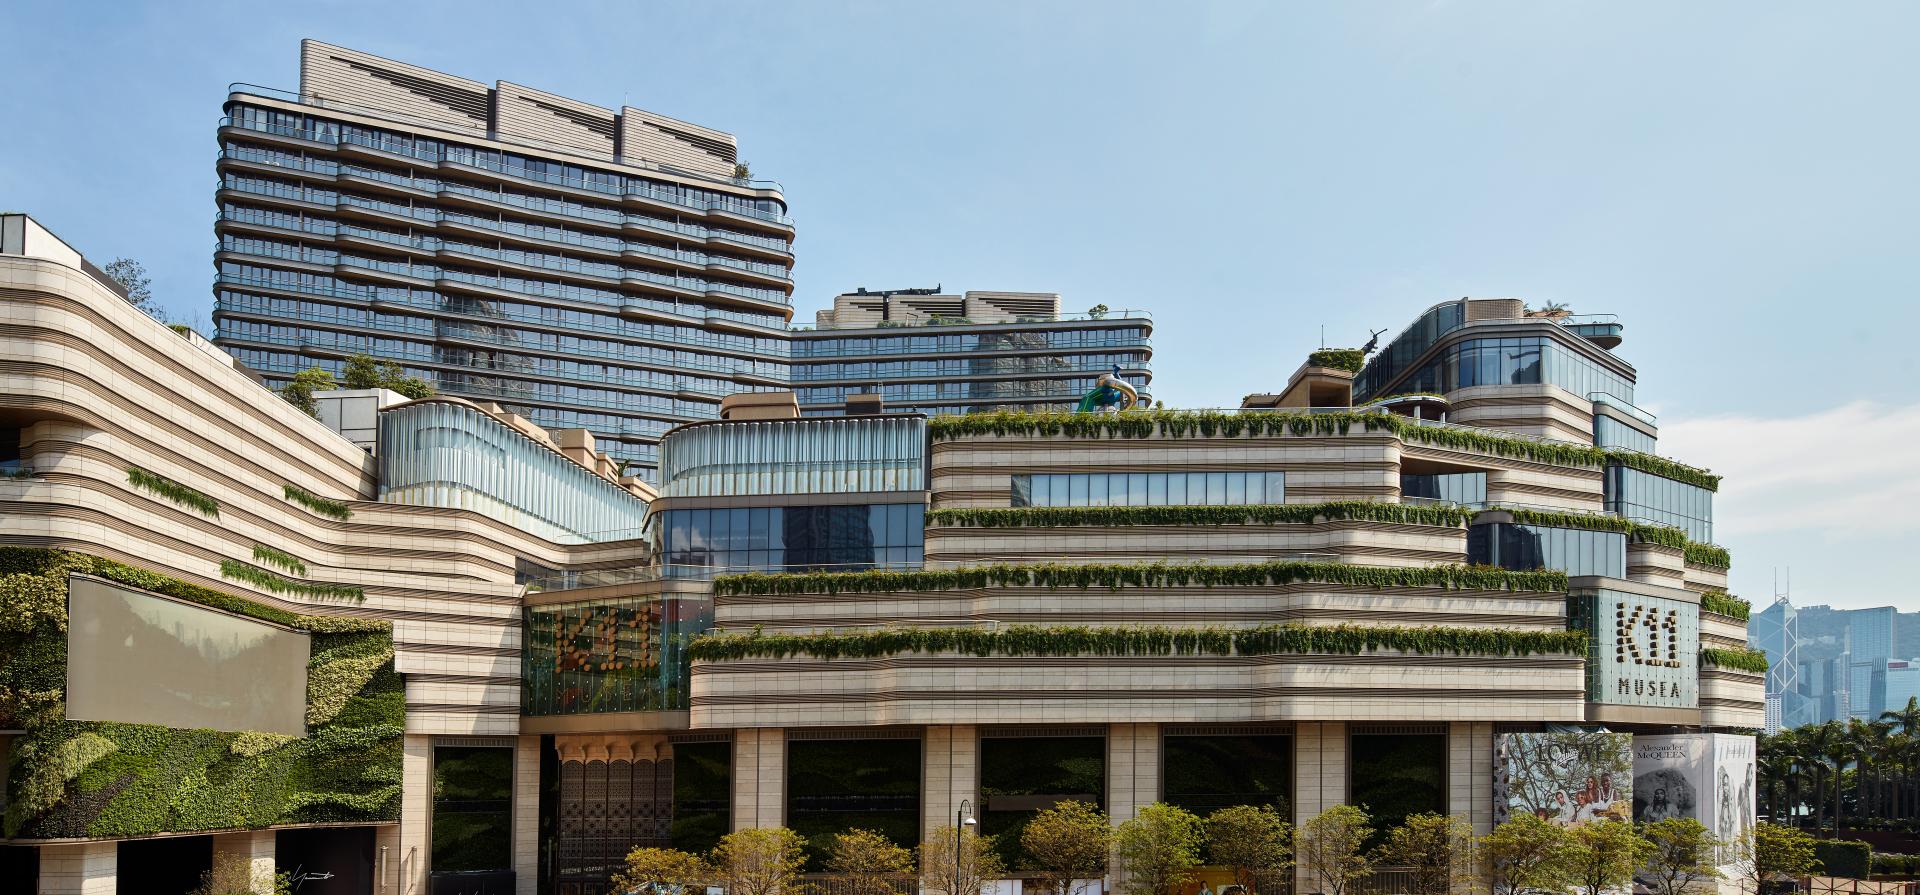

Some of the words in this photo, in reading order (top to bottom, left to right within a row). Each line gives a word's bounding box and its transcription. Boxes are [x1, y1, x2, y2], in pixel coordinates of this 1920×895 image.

[555, 605, 657, 674] K11
[1616, 602, 1680, 668] K11
[1618, 678, 1680, 698] MUSEA
[1637, 751, 1686, 760] McQUEEN
